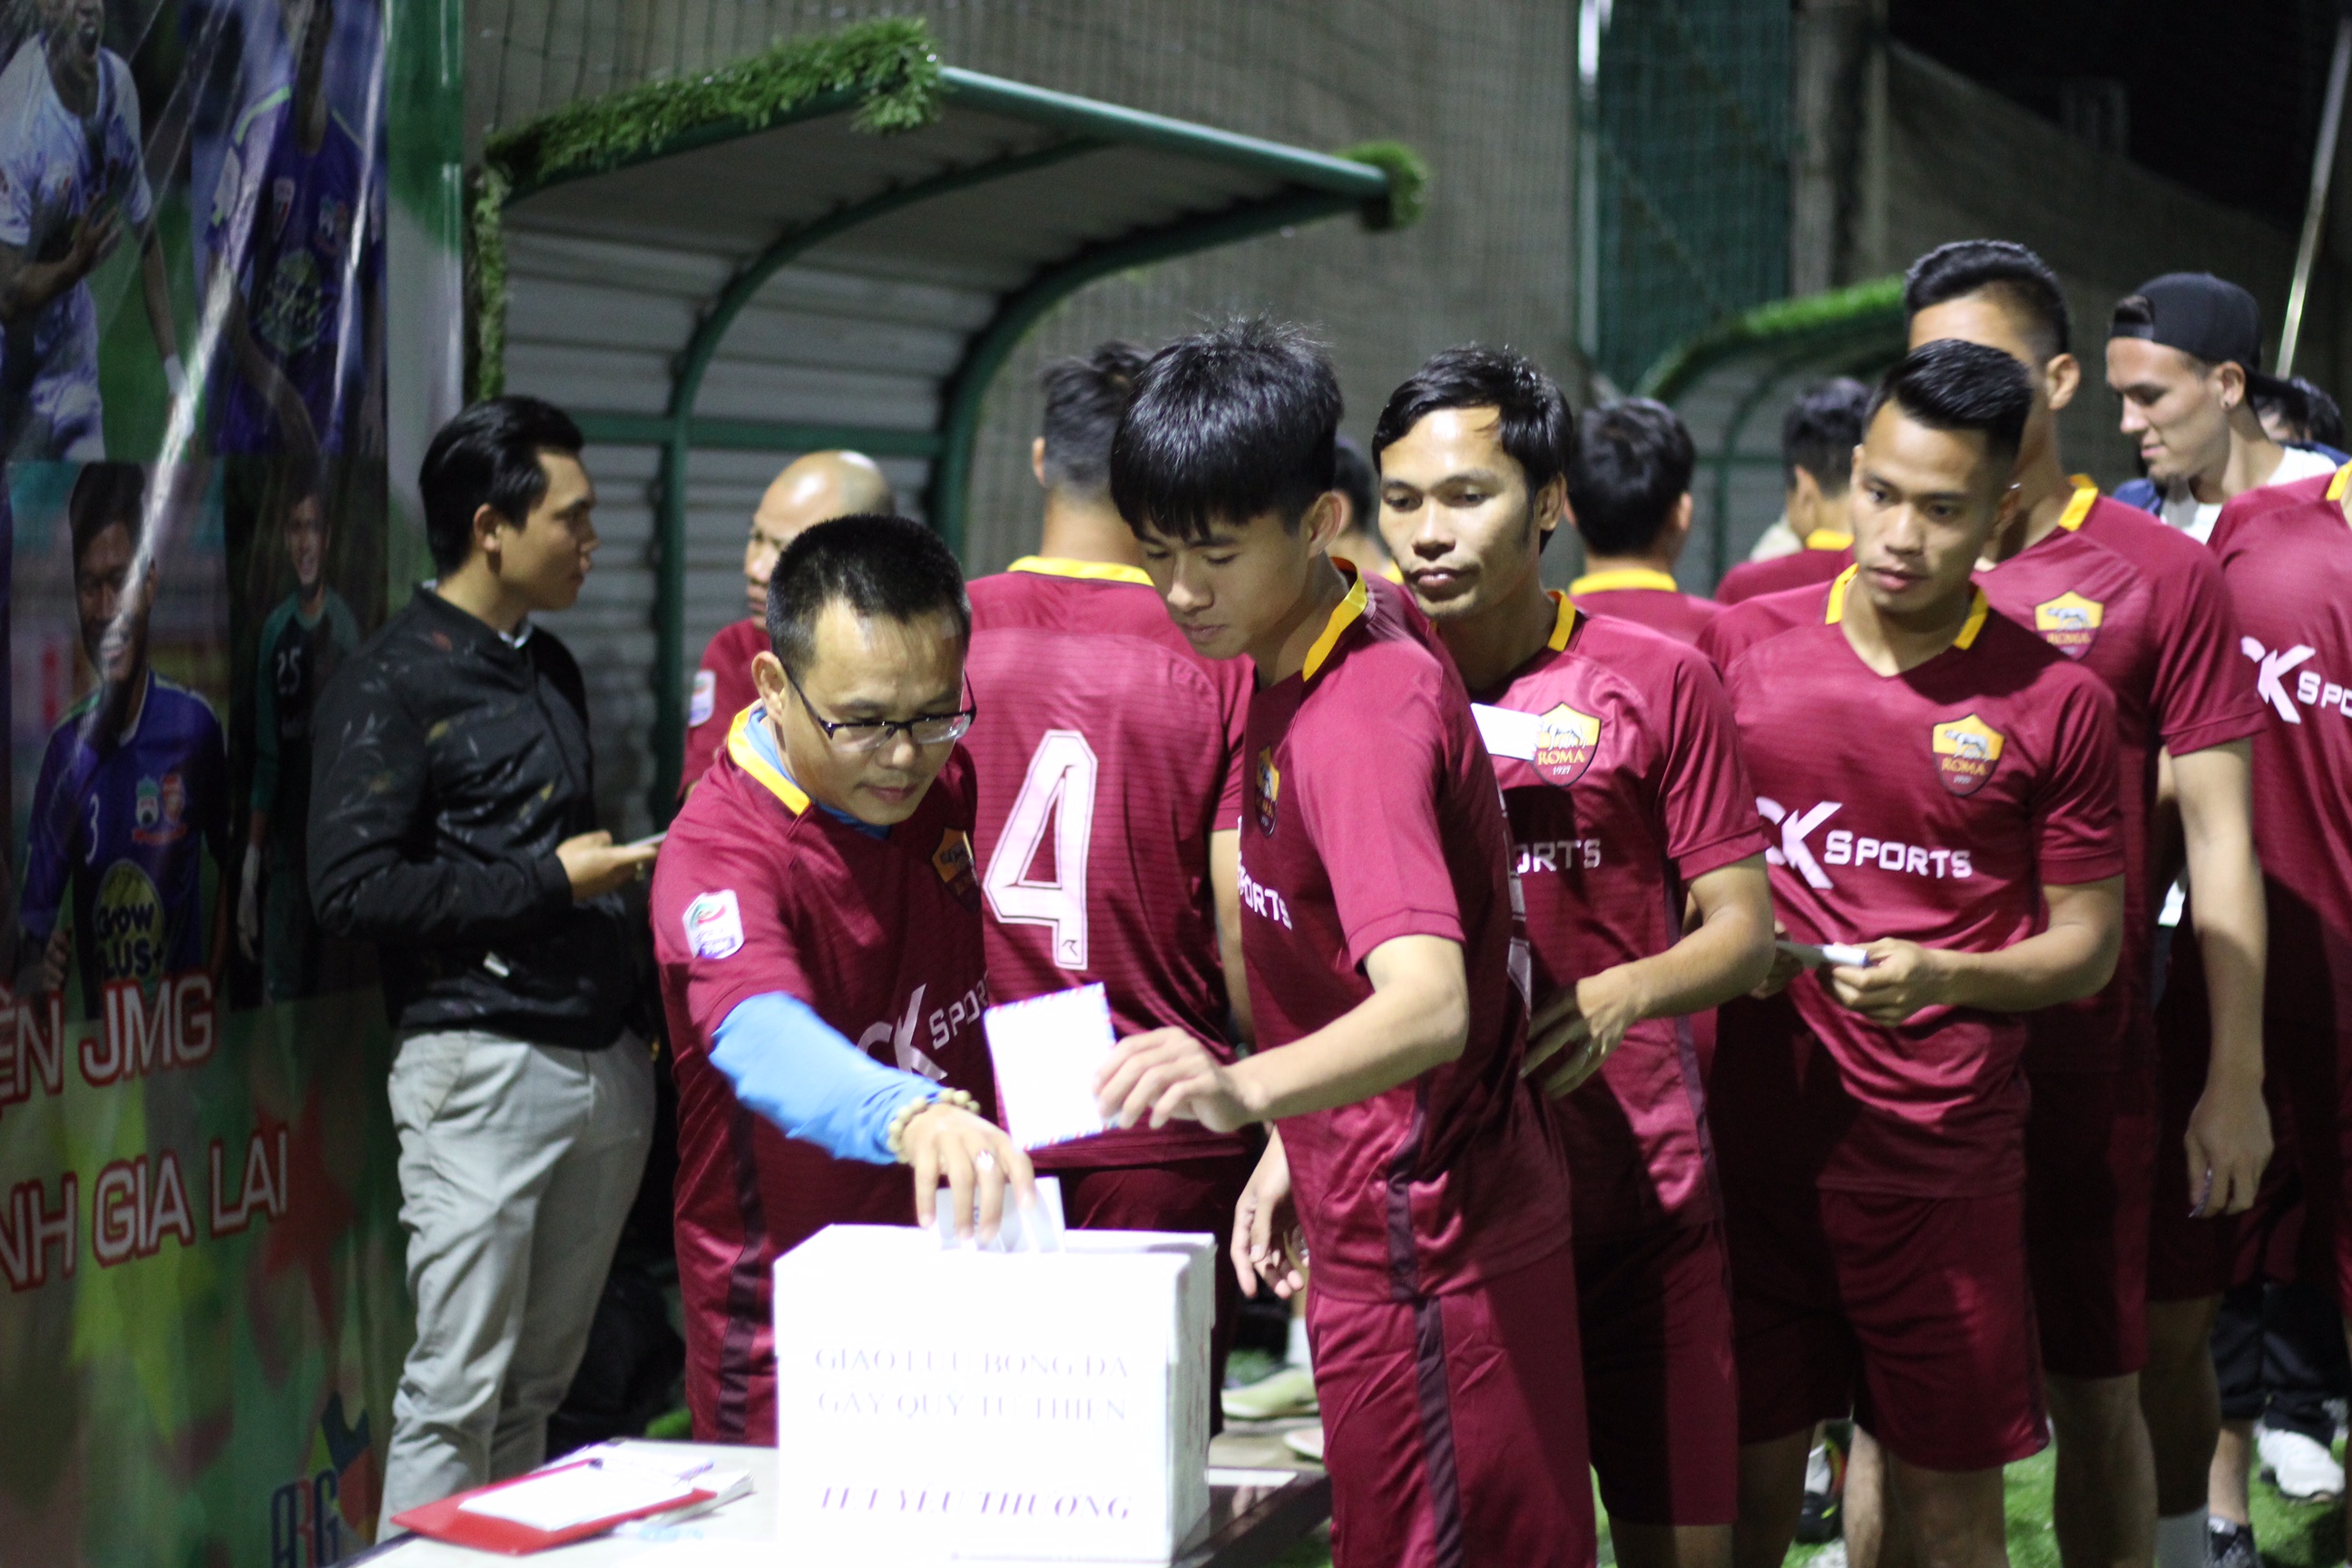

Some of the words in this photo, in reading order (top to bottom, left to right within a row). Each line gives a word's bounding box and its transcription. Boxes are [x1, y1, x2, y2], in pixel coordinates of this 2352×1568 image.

[277, 646, 302, 696] 25
[1537, 748, 1586, 766] ROMA
[1941, 756, 1987, 777] ROMA
[982, 729, 1098, 971] 4
[1824, 828, 1974, 879] SPORTS
[81, 972, 216, 1086] JMG
[93, 1149, 193, 1267] GIA
[210, 1125, 288, 1238] LAI
